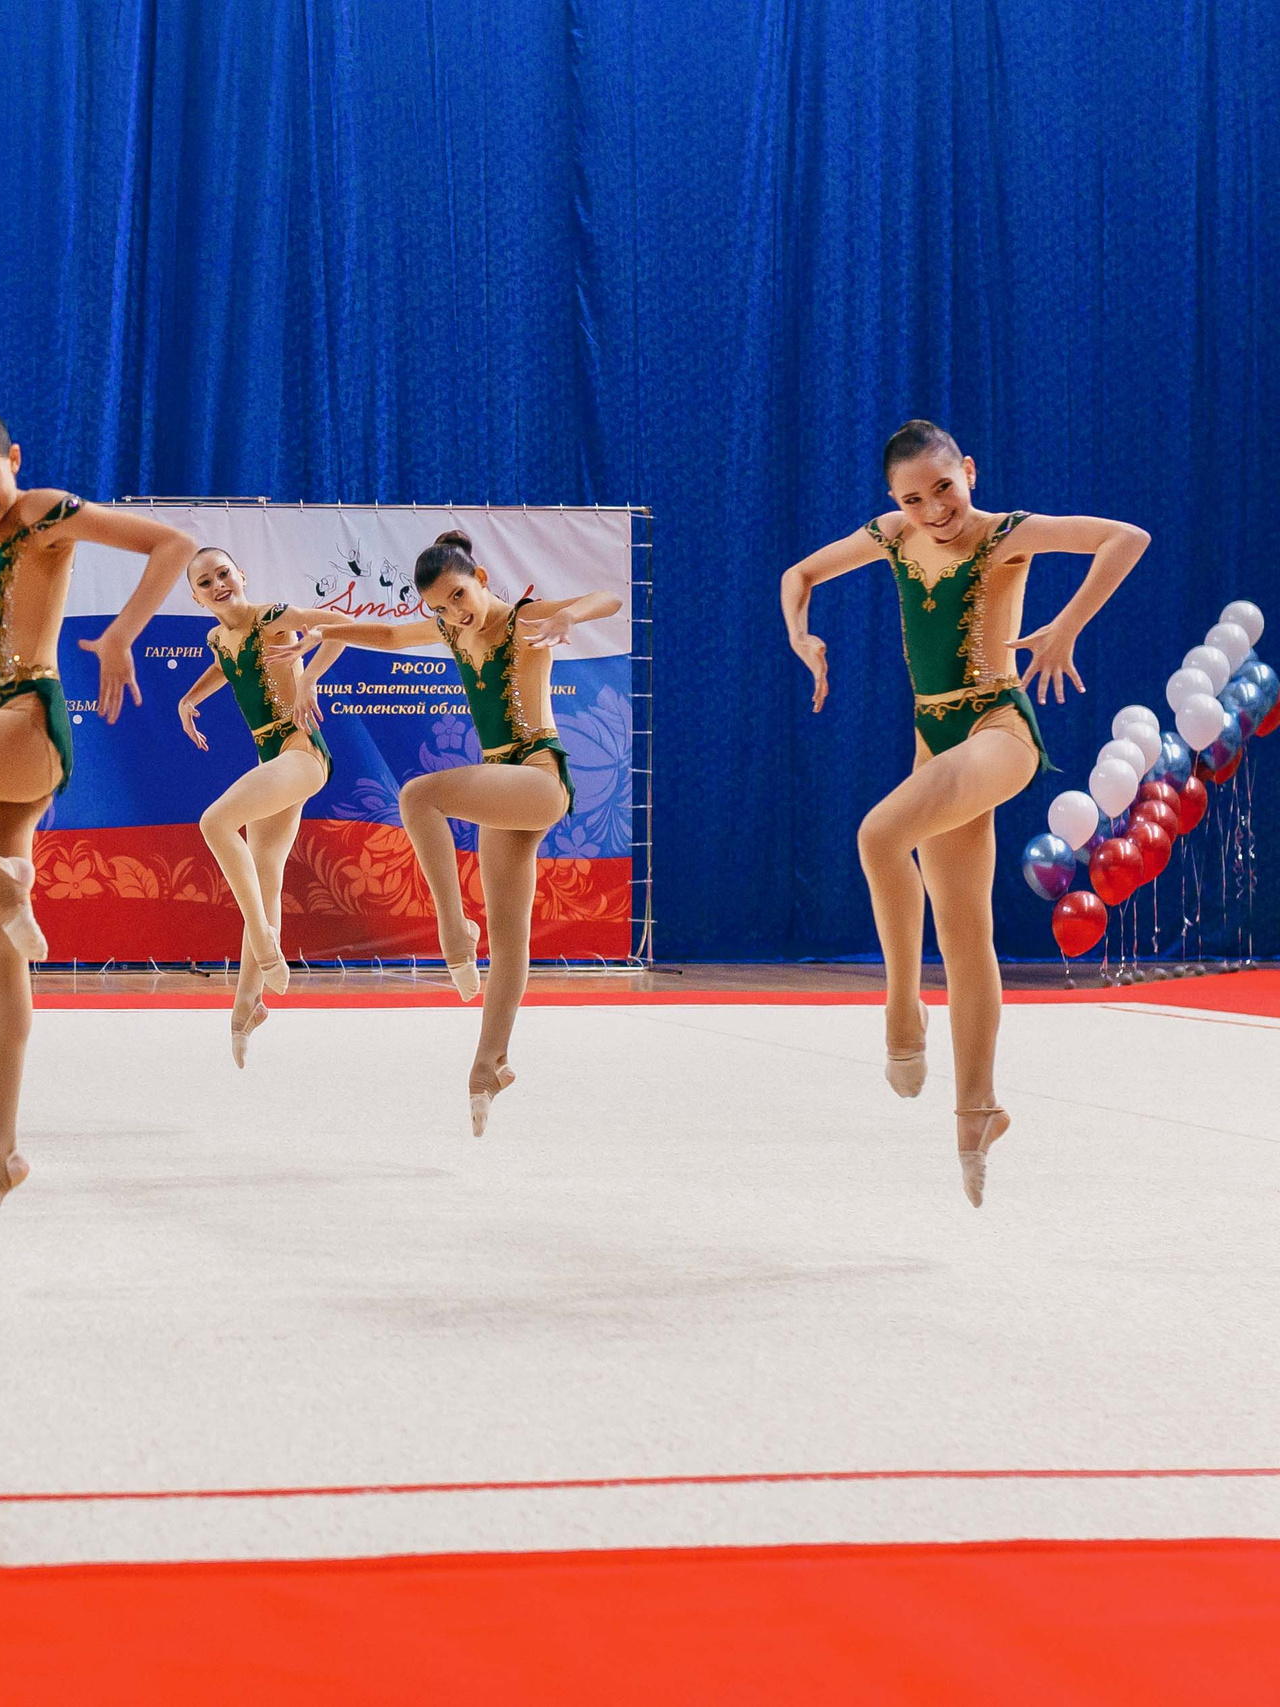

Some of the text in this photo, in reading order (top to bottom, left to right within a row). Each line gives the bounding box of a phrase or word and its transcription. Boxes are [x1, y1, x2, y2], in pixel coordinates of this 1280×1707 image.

[145, 646, 204, 658] ГАГАРИН
[391, 661, 447, 675] РФСОО
[331, 702, 426, 715] Смоленской
